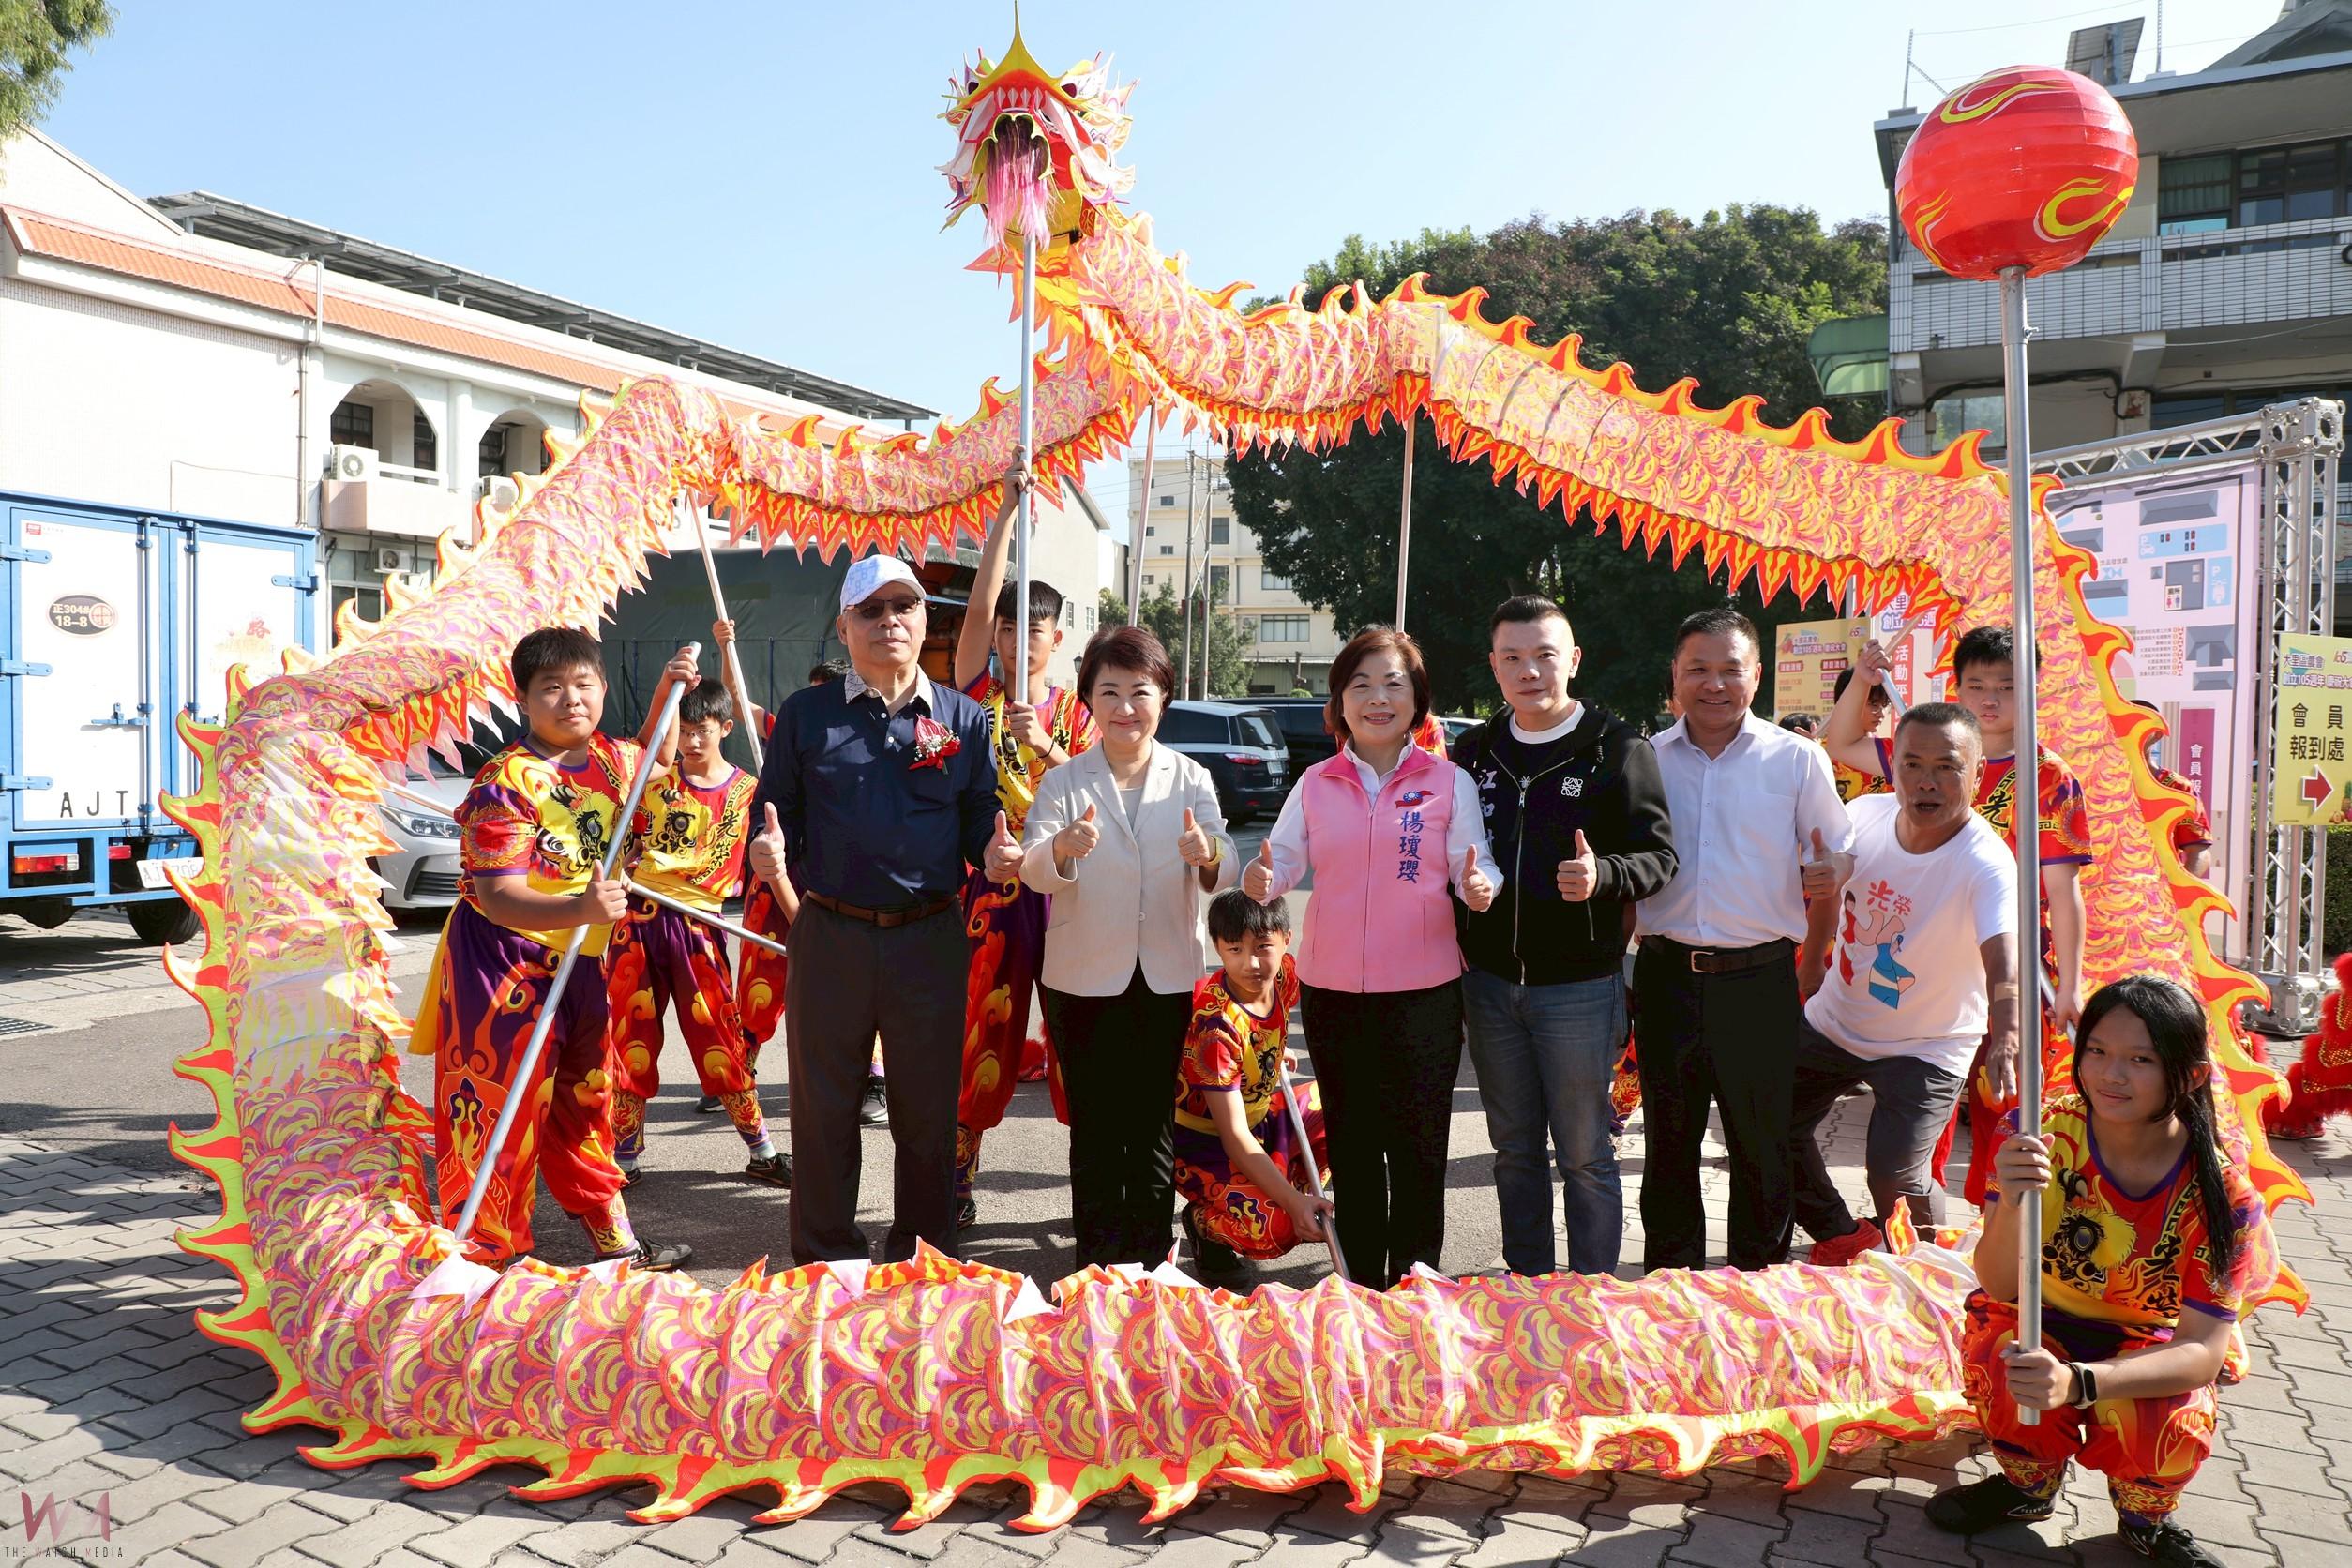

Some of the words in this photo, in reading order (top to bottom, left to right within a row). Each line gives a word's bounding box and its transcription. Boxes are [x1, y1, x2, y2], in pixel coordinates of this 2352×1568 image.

[2283, 654, 2324, 669] 大里區農會
[2289, 735, 2344, 761] 報到處
[1397, 811, 1424, 883] 楊瓊瓔
[1867, 880, 1913, 916] 光榮
